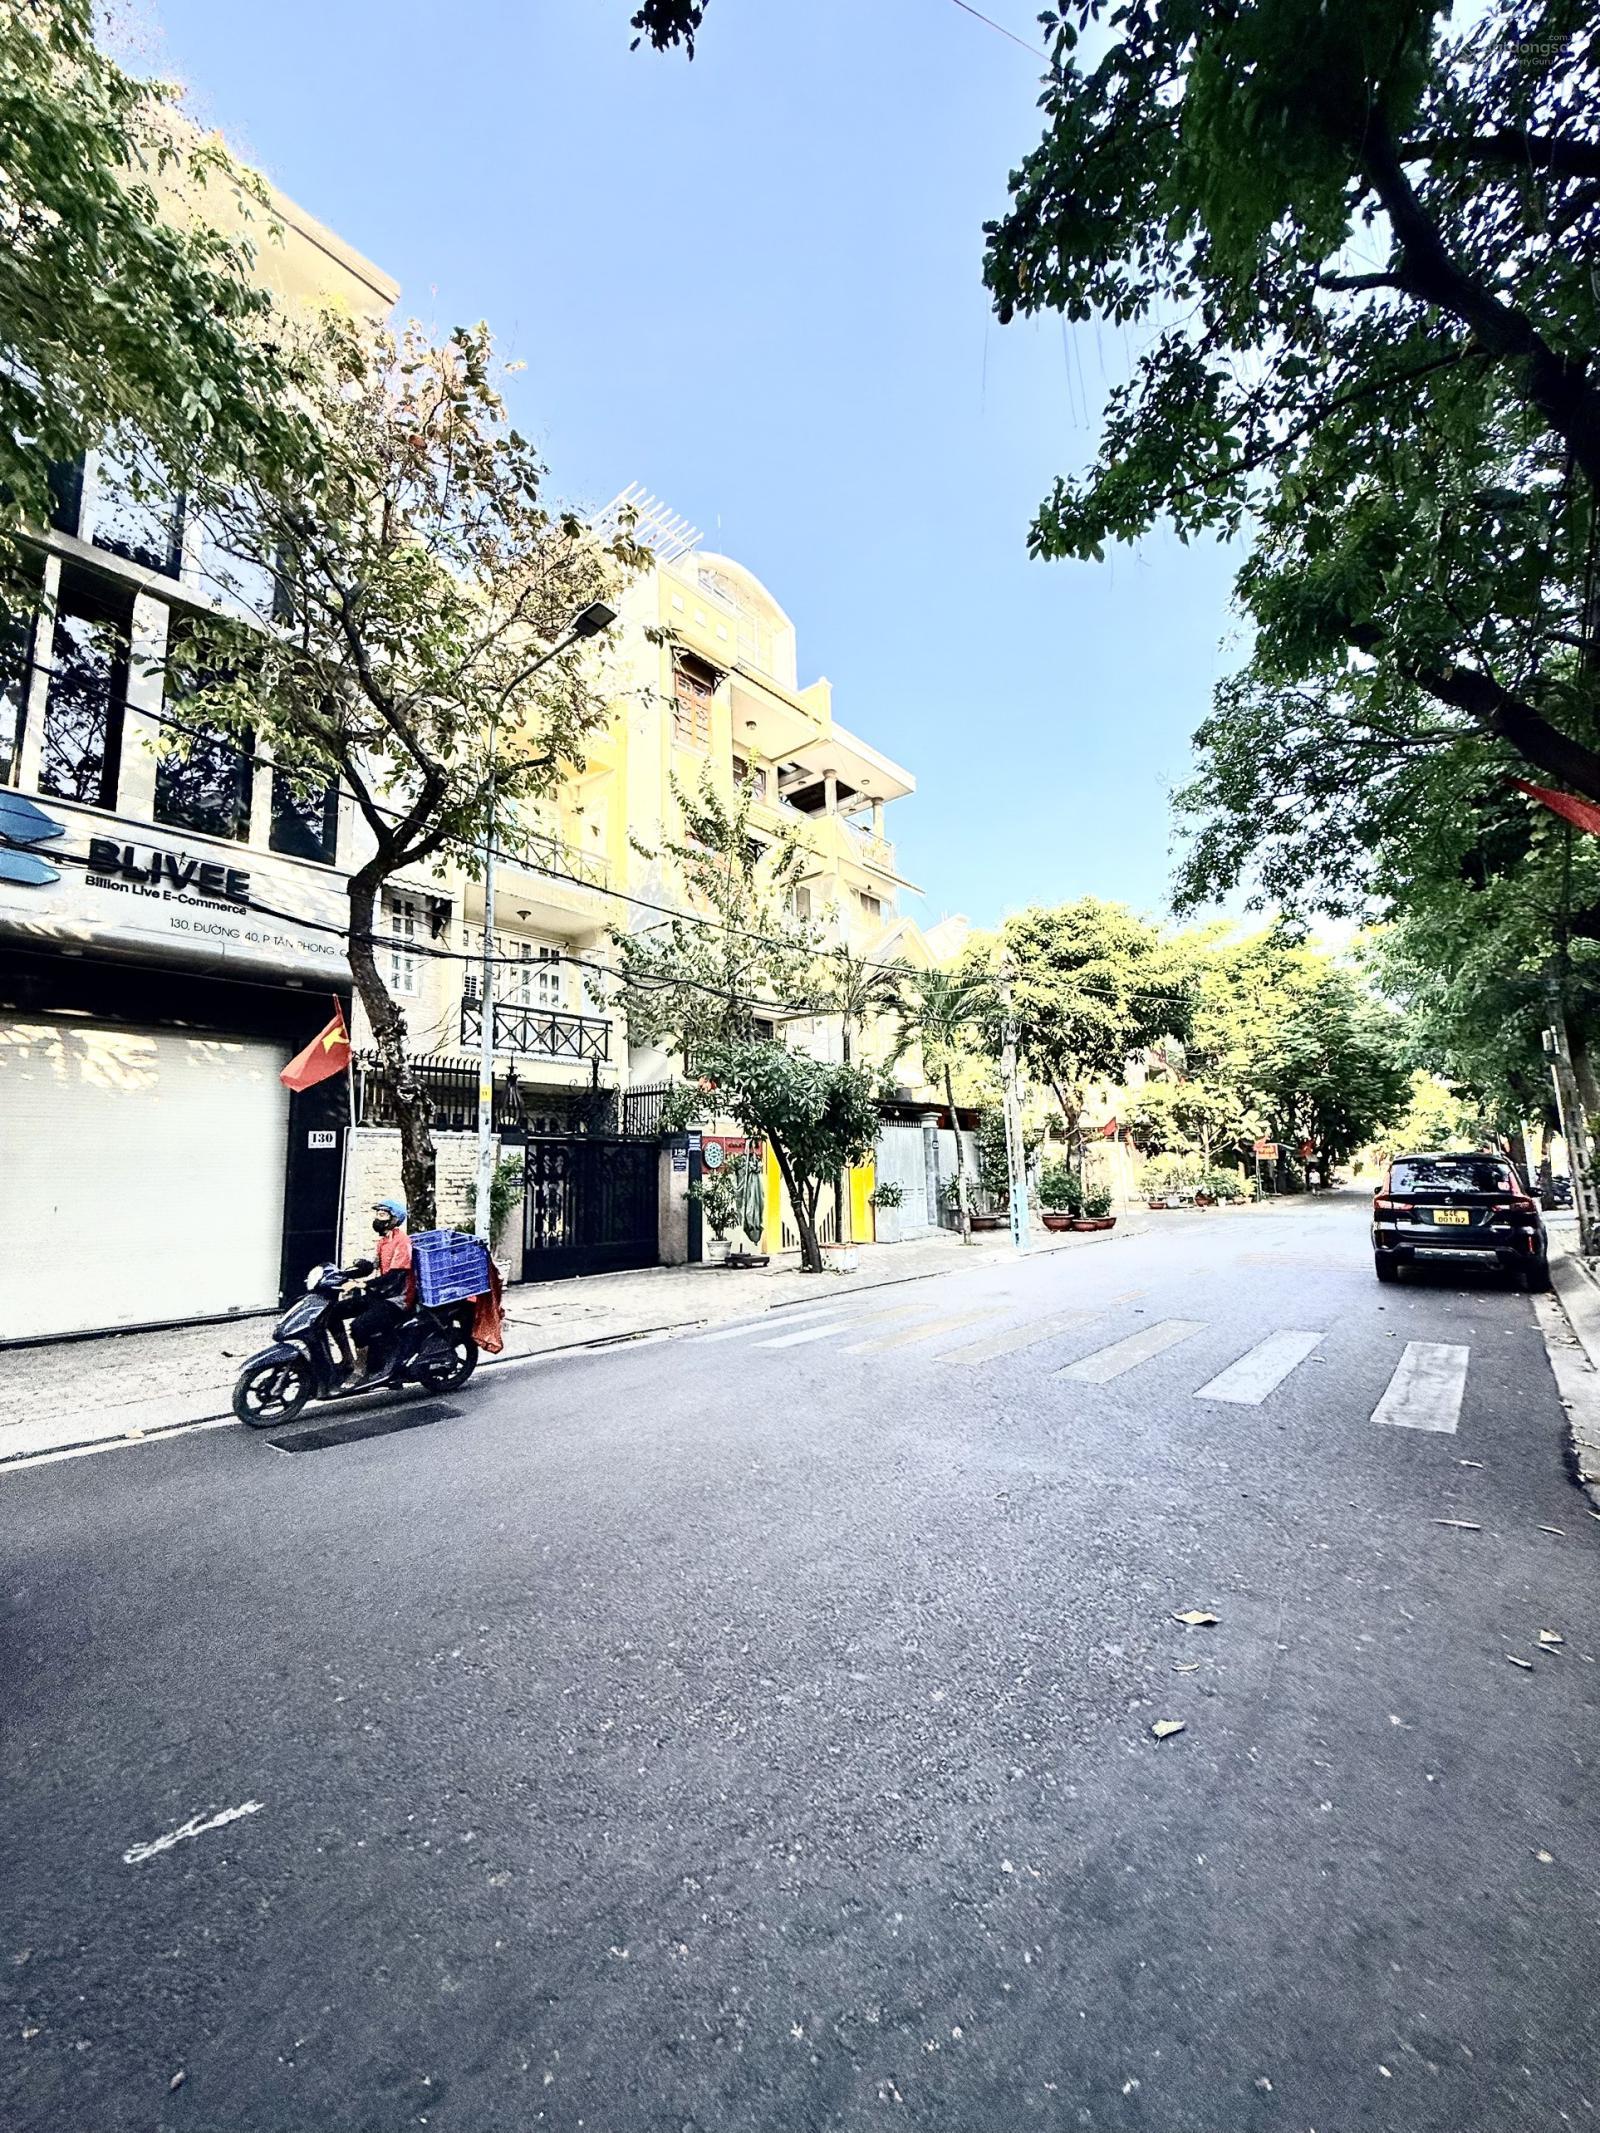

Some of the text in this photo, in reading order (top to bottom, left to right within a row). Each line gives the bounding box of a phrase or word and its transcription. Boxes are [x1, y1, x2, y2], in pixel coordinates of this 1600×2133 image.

[88, 838, 250, 902] BLIVEE
[85, 875, 247, 916] Billion Live E-Commerce
[312, 1133, 334, 1143] 130
